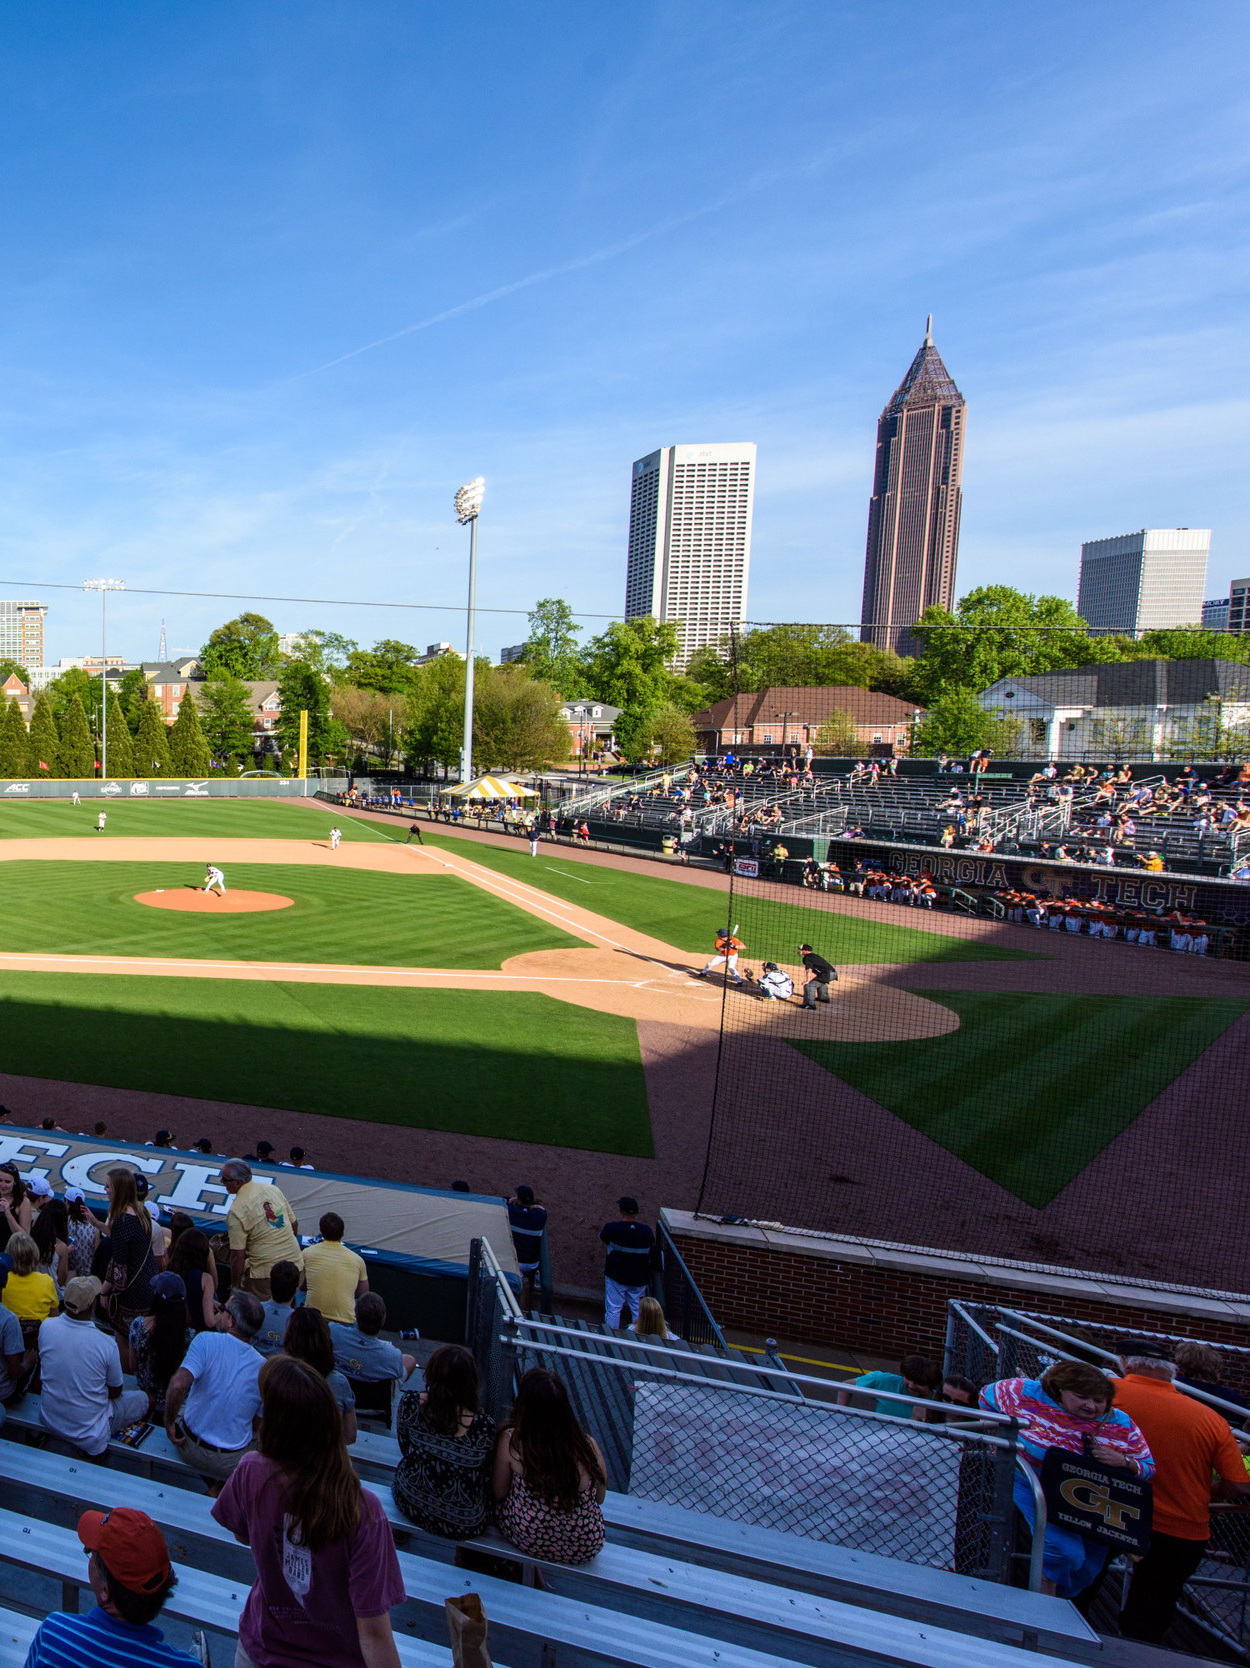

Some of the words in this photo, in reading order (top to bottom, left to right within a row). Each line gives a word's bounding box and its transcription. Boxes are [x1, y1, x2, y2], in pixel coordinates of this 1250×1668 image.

[4, 783, 30, 792] ACC
[889, 850, 1009, 888] GEORGIA
[1090, 873, 1197, 911] TECH
[1062, 1463, 1110, 1485] GEORGIA
[1111, 1478, 1143, 1496] TECH
[1060, 1478, 1141, 1531] GT
[1058, 1512, 1092, 1529] YELLOW
[1096, 1525, 1140, 1547] JACKETS
